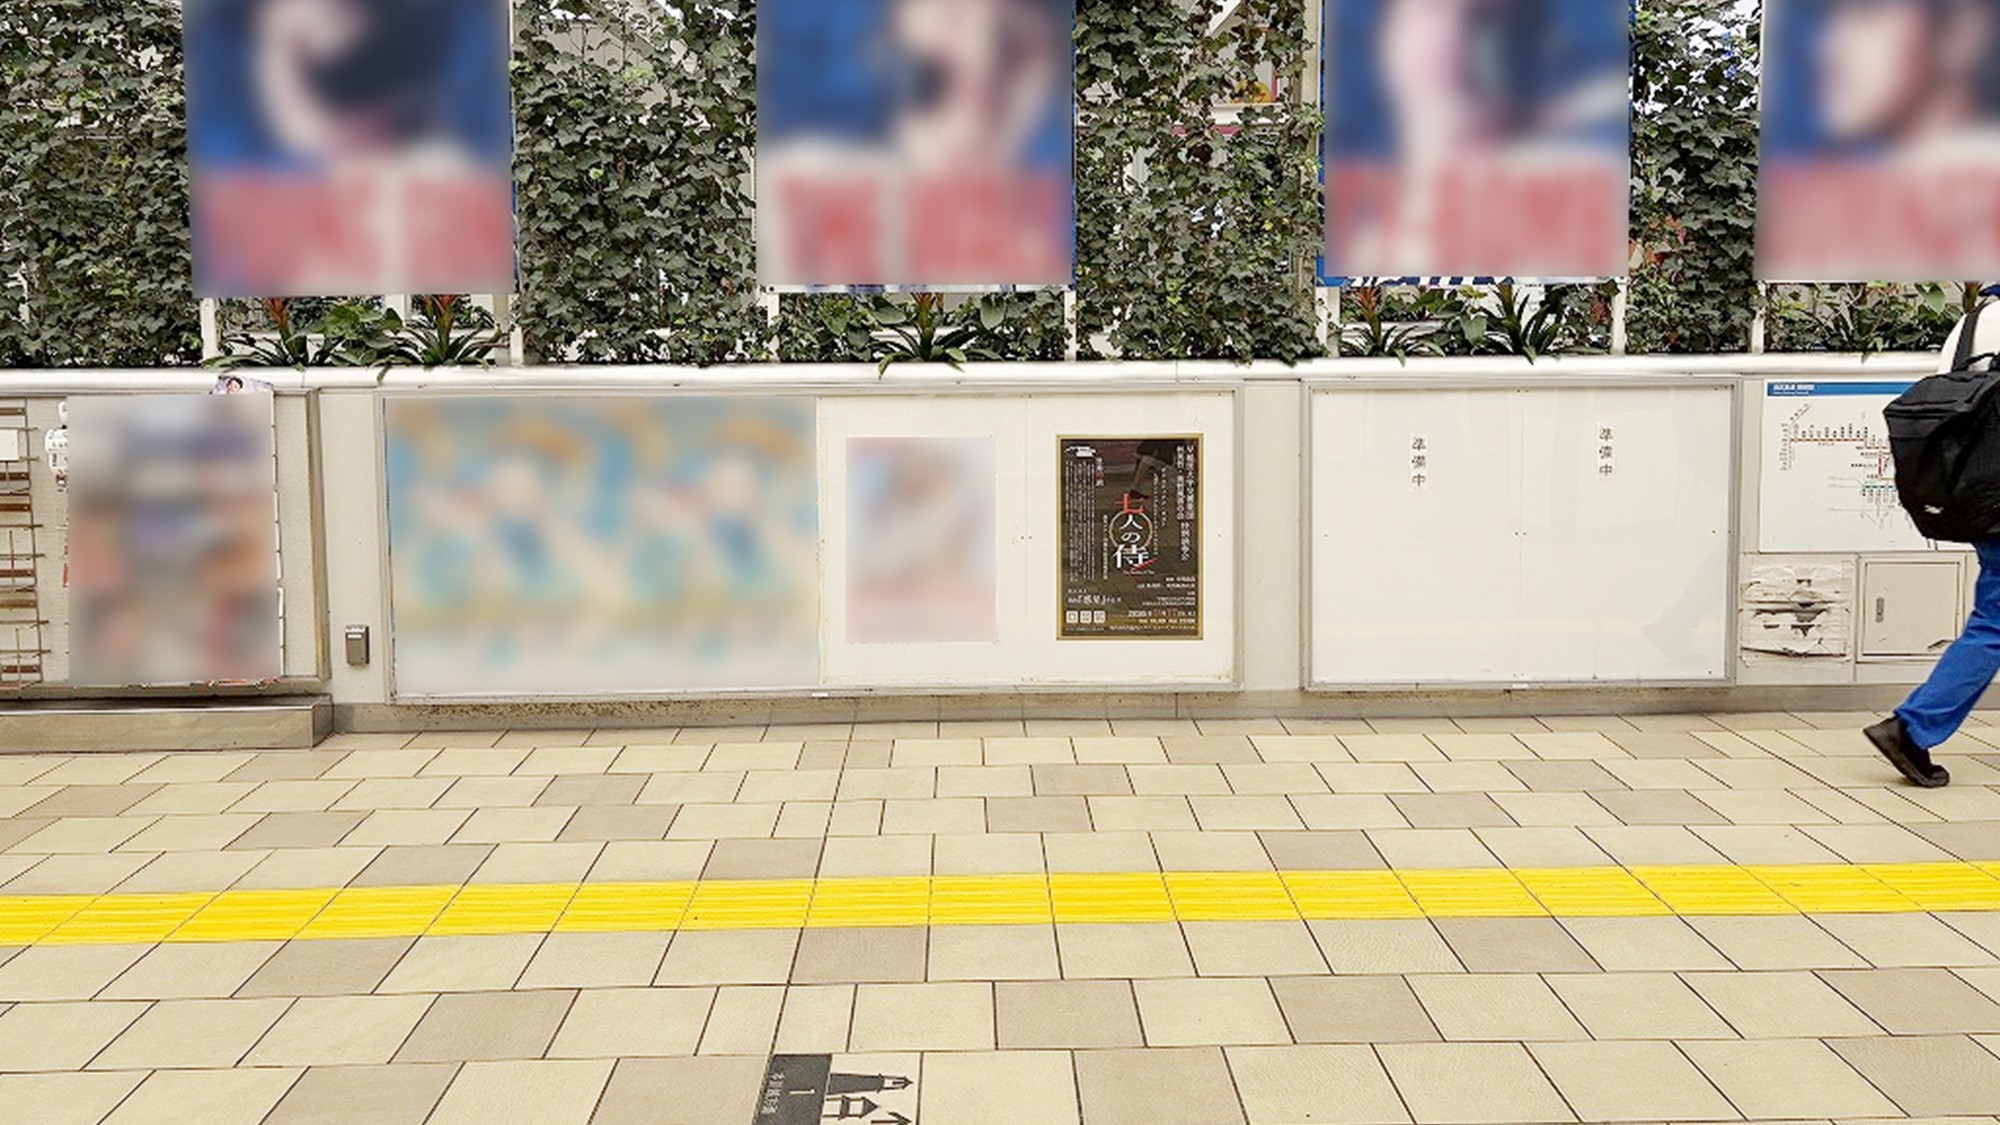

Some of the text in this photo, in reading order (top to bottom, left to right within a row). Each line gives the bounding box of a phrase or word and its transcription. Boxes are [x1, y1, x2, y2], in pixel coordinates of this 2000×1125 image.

[1411, 436, 1427, 487] 準備中
[1599, 427, 1613, 477] 準備中
[1113, 492, 1152, 569] 七人の侍
